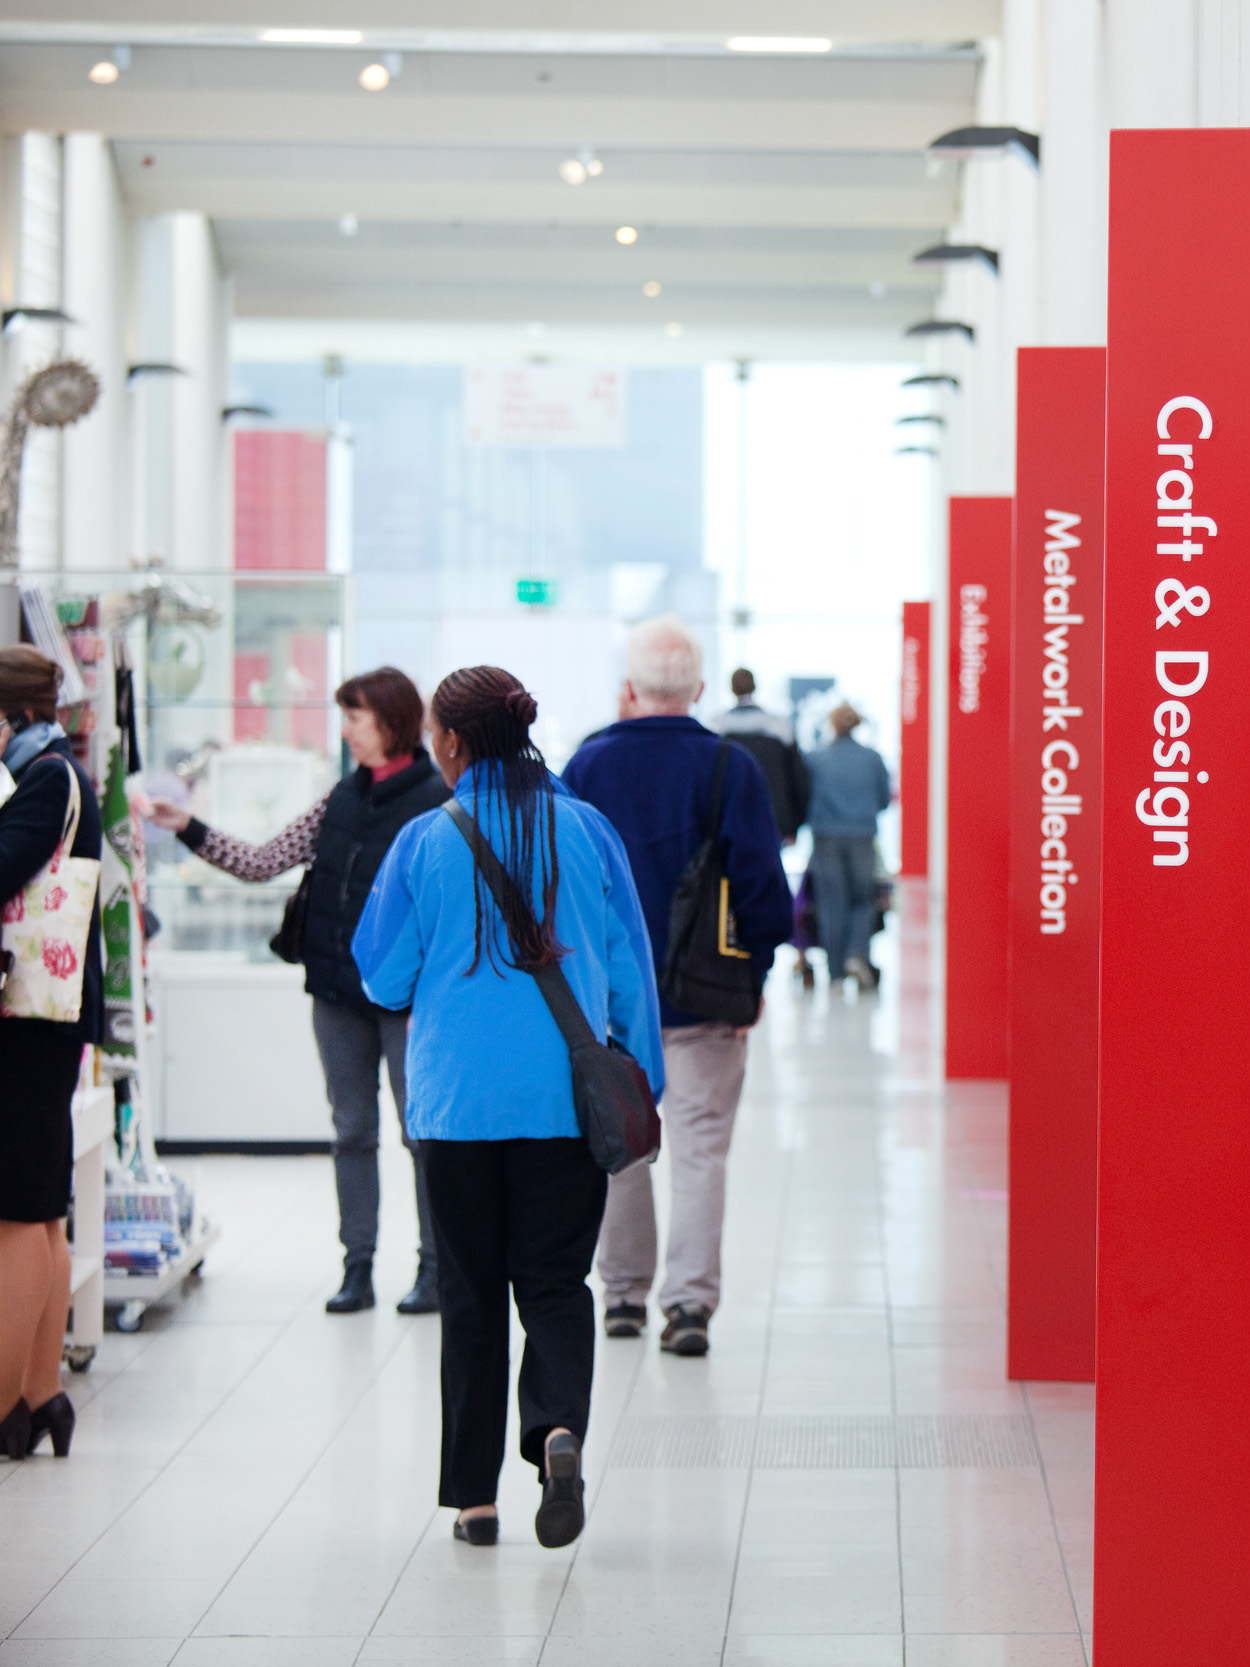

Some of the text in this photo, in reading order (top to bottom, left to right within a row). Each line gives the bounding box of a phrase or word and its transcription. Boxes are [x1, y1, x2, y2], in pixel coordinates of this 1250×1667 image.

[1039, 507, 1084, 934] Metalwork Collection
[1135, 395, 1218, 867] Craft & Design
